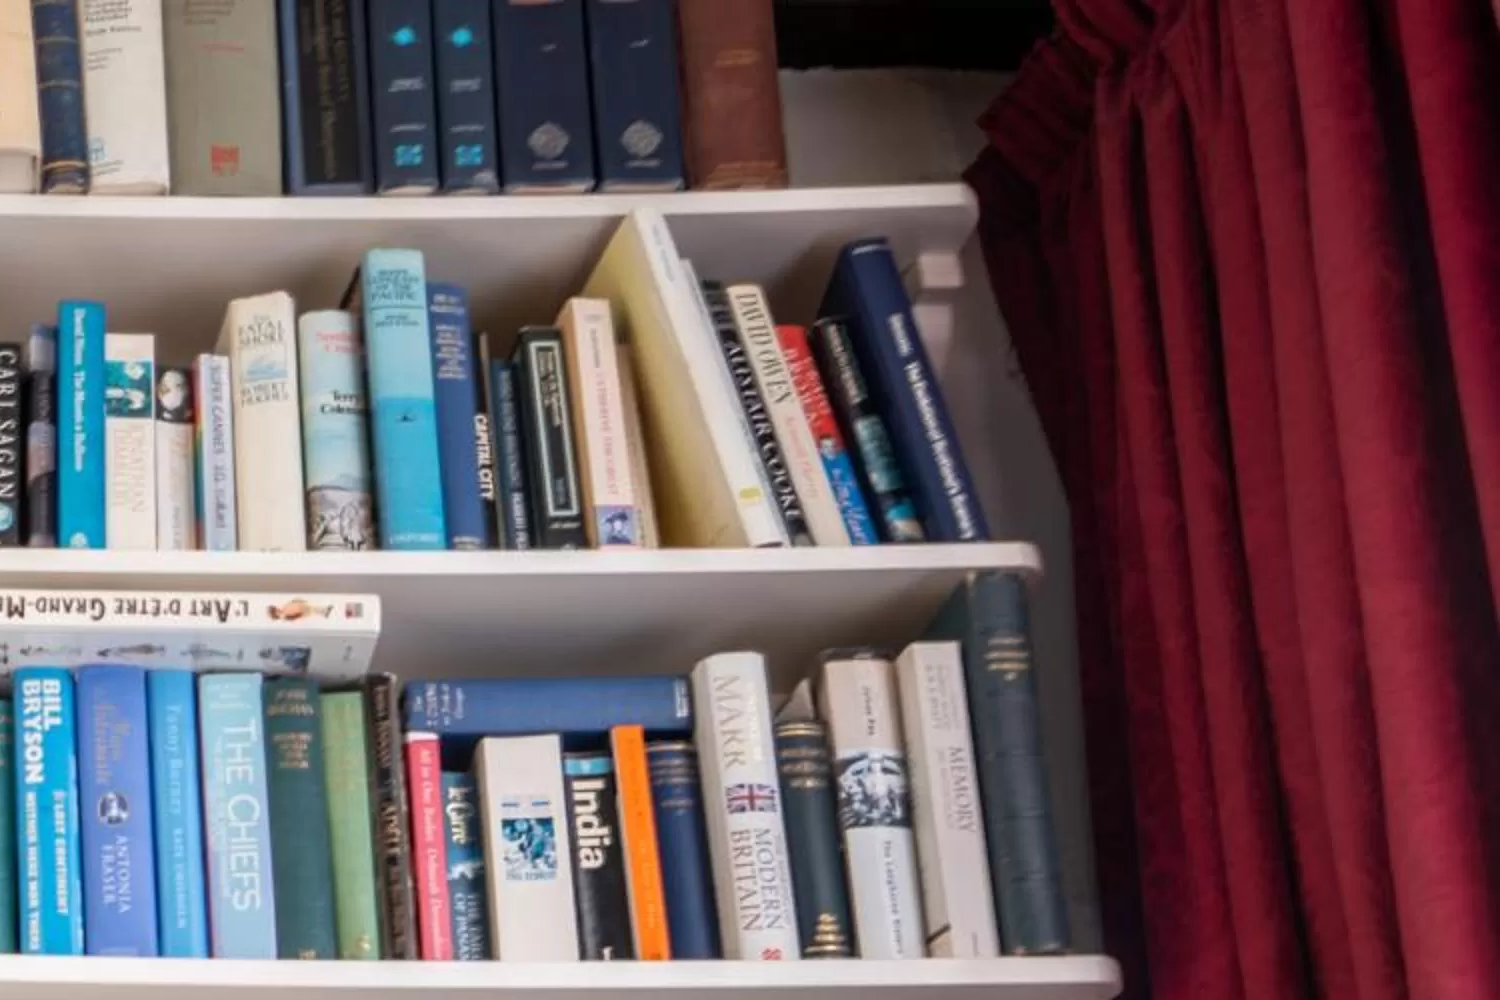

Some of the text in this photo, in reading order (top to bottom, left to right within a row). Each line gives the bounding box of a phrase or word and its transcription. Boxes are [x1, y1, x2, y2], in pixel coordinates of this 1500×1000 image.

[478, 469, 495, 500] CITY
[22, 679, 45, 785] BRYSON
[40, 678, 62, 731] BILL
[713, 675, 747, 769] MARR
[222, 717, 261, 912] THE CHIEFS
[572, 779, 613, 869] India
[949, 745, 976, 833] MEMORY
[115, 835, 133, 914] ANTONIA
[730, 829, 765, 932] BRITAIN
[754, 828, 787, 930] MODERN
